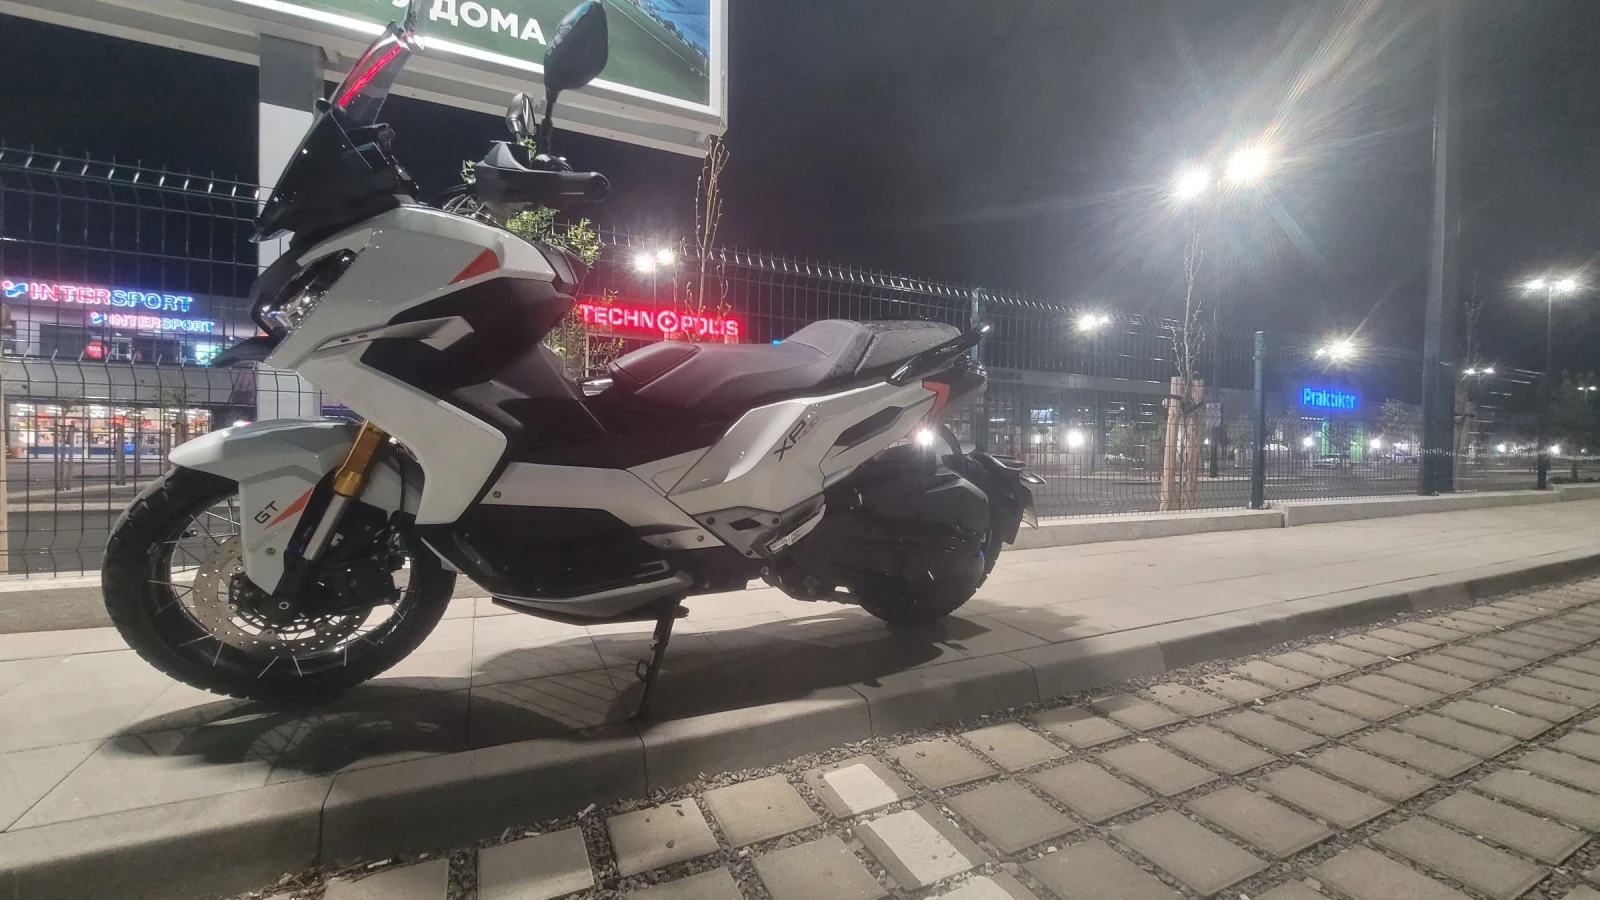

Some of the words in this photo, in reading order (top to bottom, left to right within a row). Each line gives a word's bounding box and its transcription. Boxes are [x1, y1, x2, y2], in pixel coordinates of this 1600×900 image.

[430, 0, 547, 46] ДОМА
[30, 282, 193, 312] INTERSPORT
[109, 313, 214, 333] INTERSPORT
[579, 304, 738, 336] TECHNOPOLIS
[1302, 387, 1356, 409] Praktiker
[773, 419, 806, 462] XP
[254, 500, 279, 525] GT
